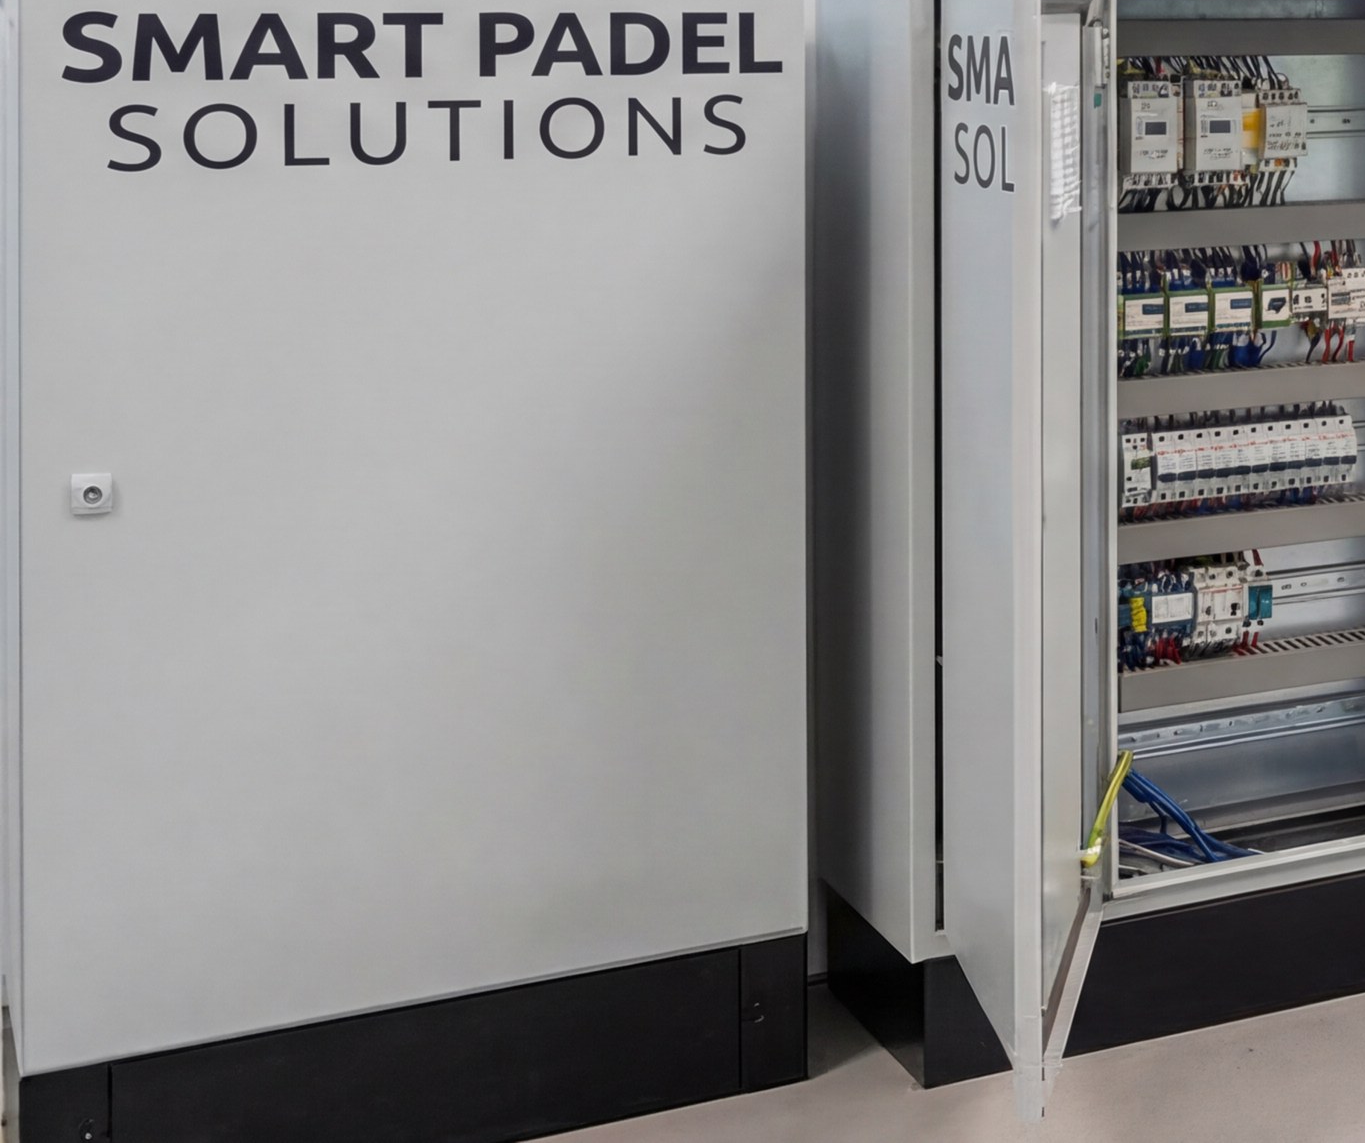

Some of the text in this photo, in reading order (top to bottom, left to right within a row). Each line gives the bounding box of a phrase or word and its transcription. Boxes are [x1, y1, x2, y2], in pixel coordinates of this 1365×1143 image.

[62, 11, 783, 84] SMART PADEL
[108, 94, 747, 173] SOLUTIONS
